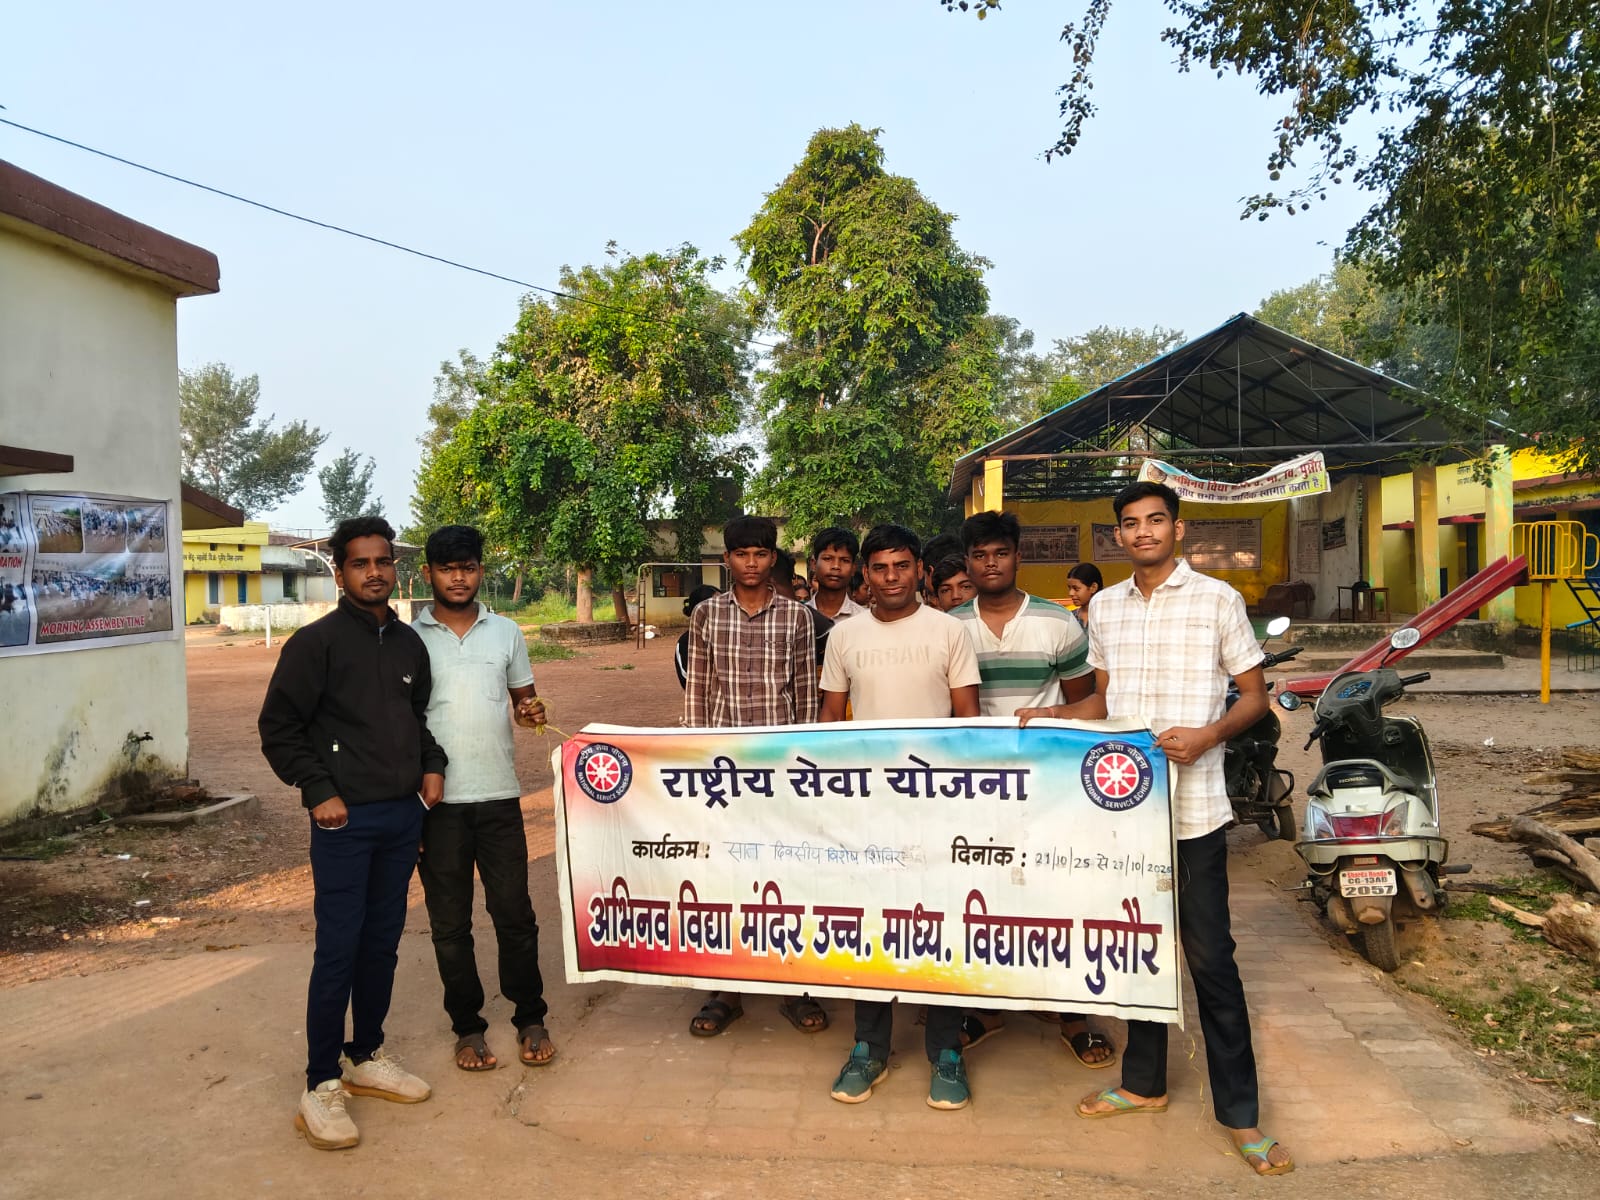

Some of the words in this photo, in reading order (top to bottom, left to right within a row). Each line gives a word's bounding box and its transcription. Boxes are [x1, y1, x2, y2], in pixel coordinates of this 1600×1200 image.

[41, 621, 84, 636] MORNING
[85, 616, 125, 631] ASSEMBLY
[126, 615, 145, 627] TIME
[856, 645, 930, 669] URBAN
[1085, 746, 1105, 767] राष्ट्रीय
[1105, 742, 1125, 752] सेवा
[1127, 746, 1149, 770] योजना
[660, 755, 775, 809] राष्ट्रीय
[786, 755, 872, 798] सेवा
[884, 753, 1030, 801] योजना
[1083, 774, 1104, 805] NATIONAL
[1104, 797, 1135, 809] SERVICE
[1133, 775, 1151, 802] SCHEME
[1338, 776, 1368, 784] HONDA
[951, 835, 1015, 867] दिनांक
[1345, 886, 1393, 896] 2057
[590, 876, 671, 946] अभिनव
[678, 880, 733, 950] विद्या
[740, 880, 805, 957] मंदिर
[882, 902, 951, 963] माध्य.
[963, 889, 1074, 969] विद्यालय
[1083, 896, 1163, 995] पुसौर
